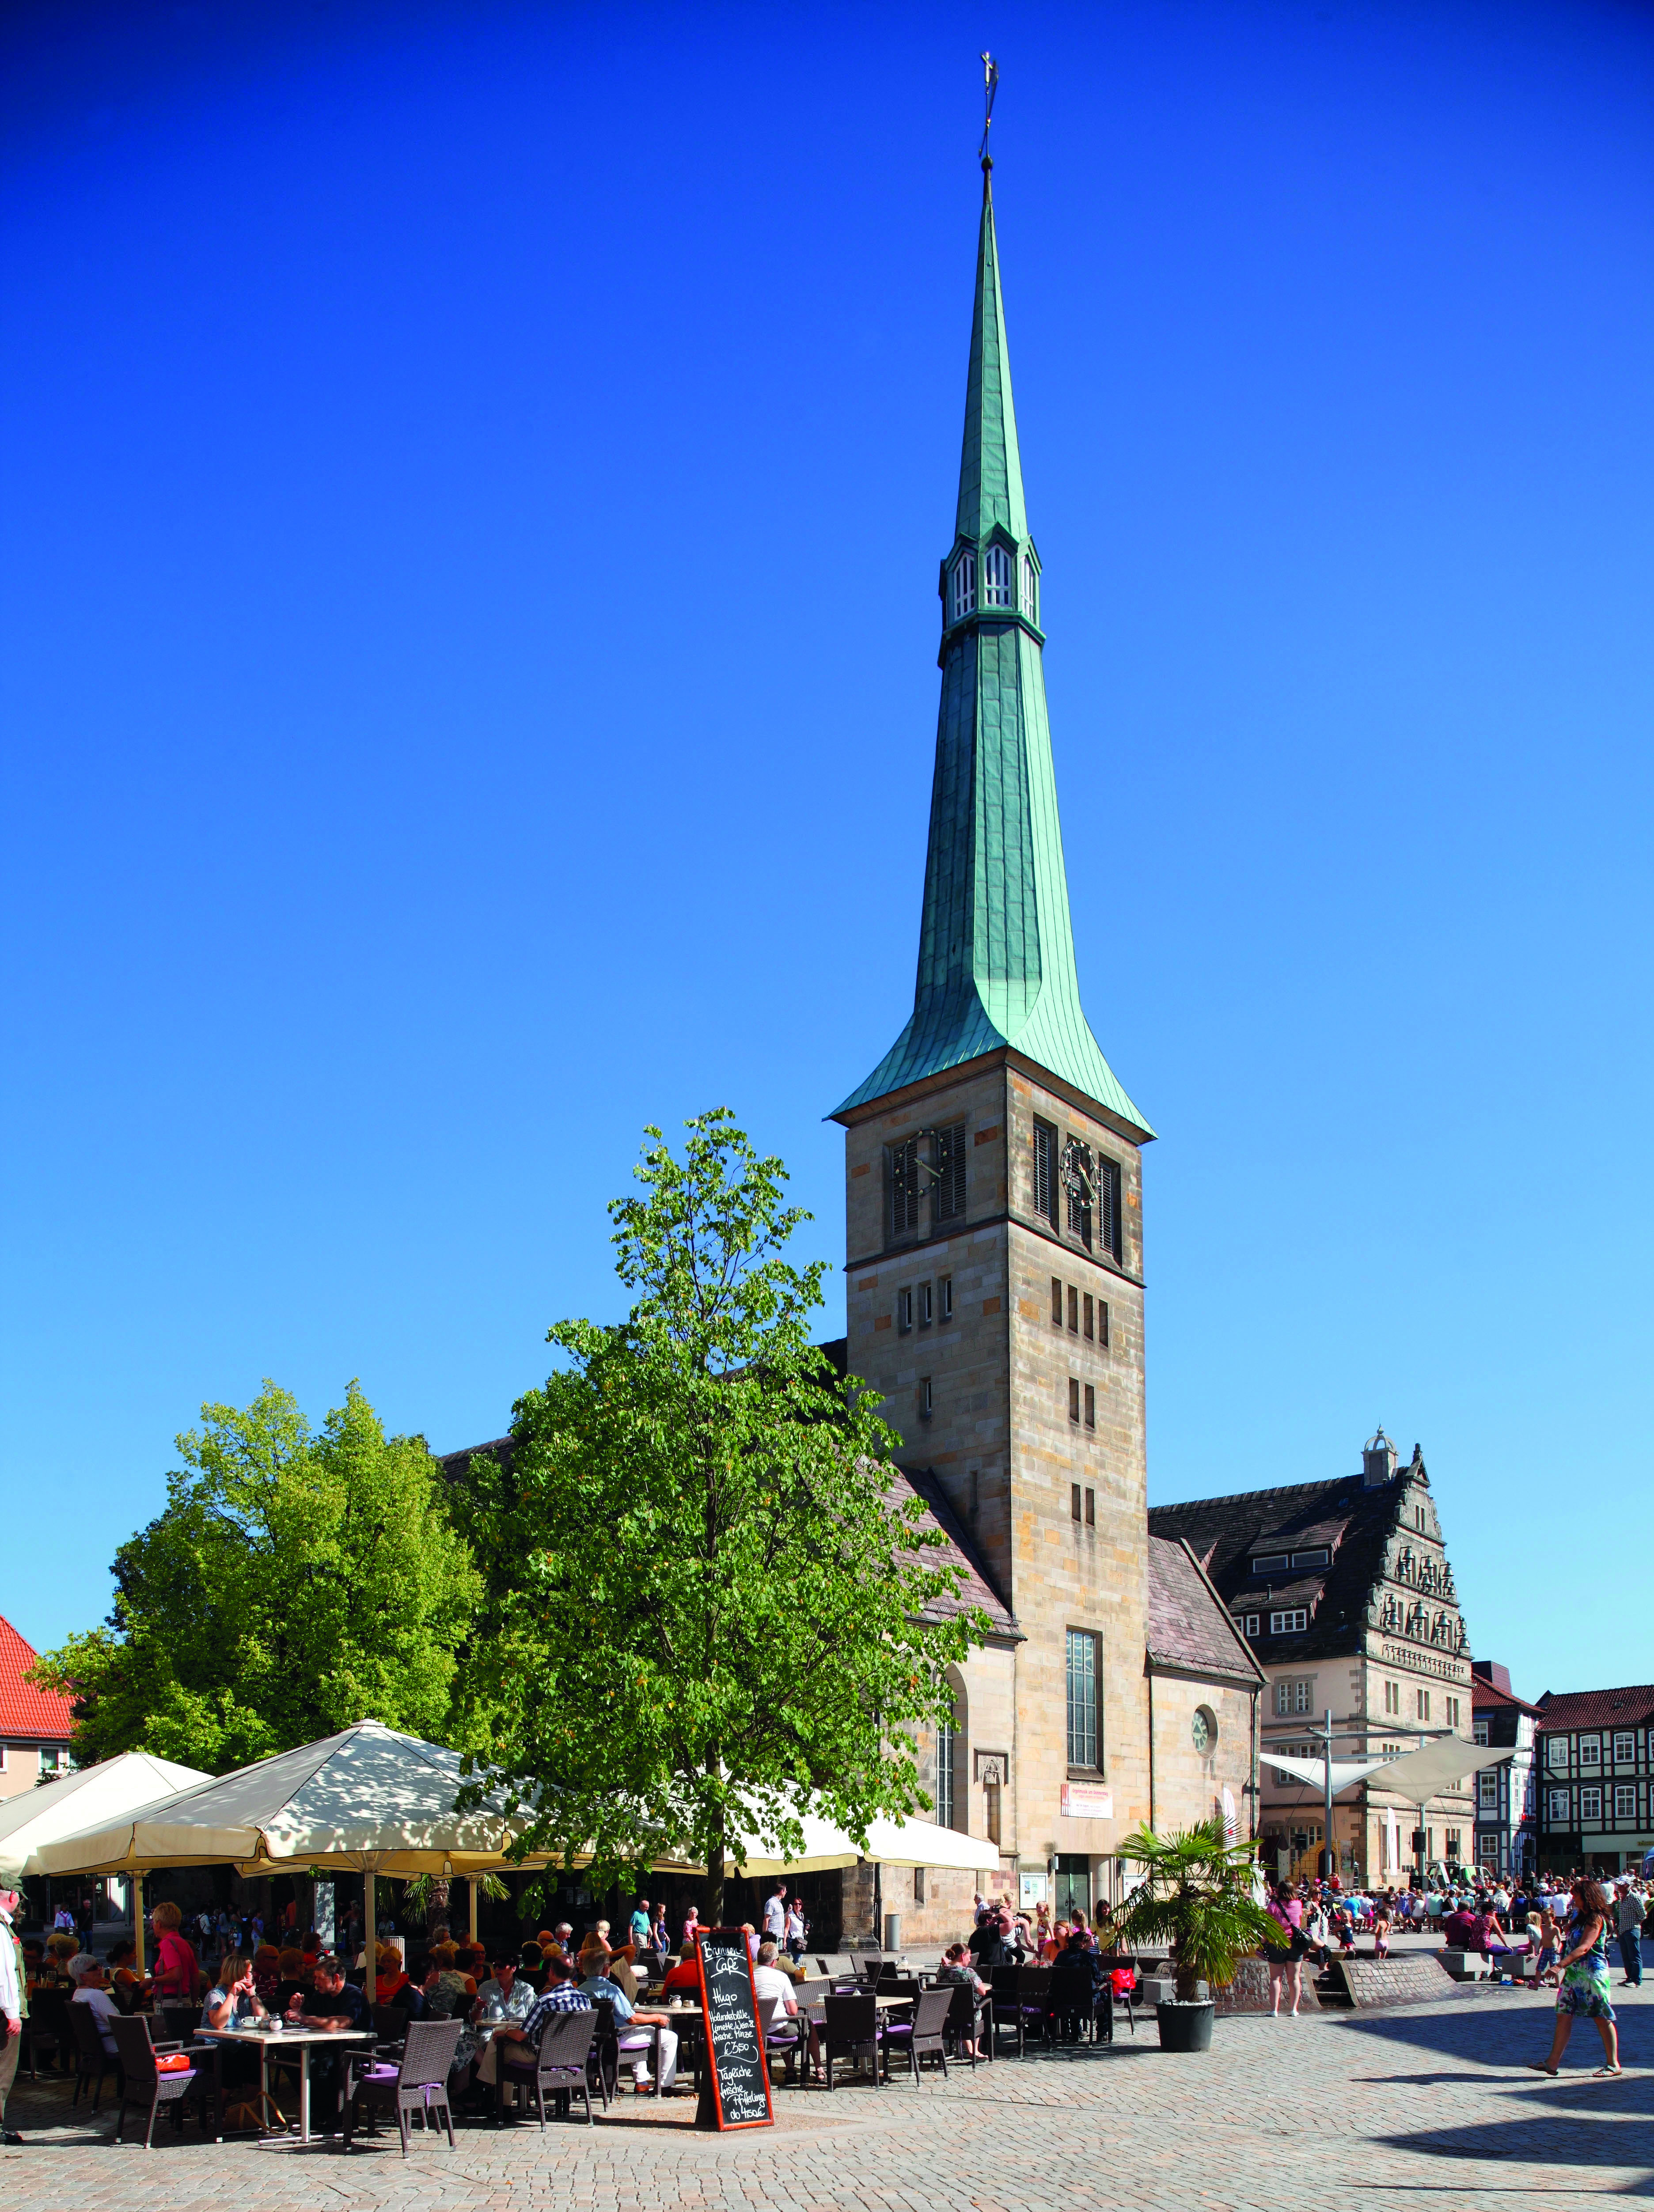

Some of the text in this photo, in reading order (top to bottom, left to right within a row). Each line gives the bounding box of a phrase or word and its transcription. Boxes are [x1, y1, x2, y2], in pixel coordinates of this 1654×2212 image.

[702, 1941, 743, 1958] Brunnen-
[716, 1957, 739, 1975] Café
[713, 1988, 737, 2006] Hugo
[713, 2030, 753, 2045] frische Minze
[717, 2065, 753, 2086] Tägliche
[720, 2083, 746, 2099] frische
